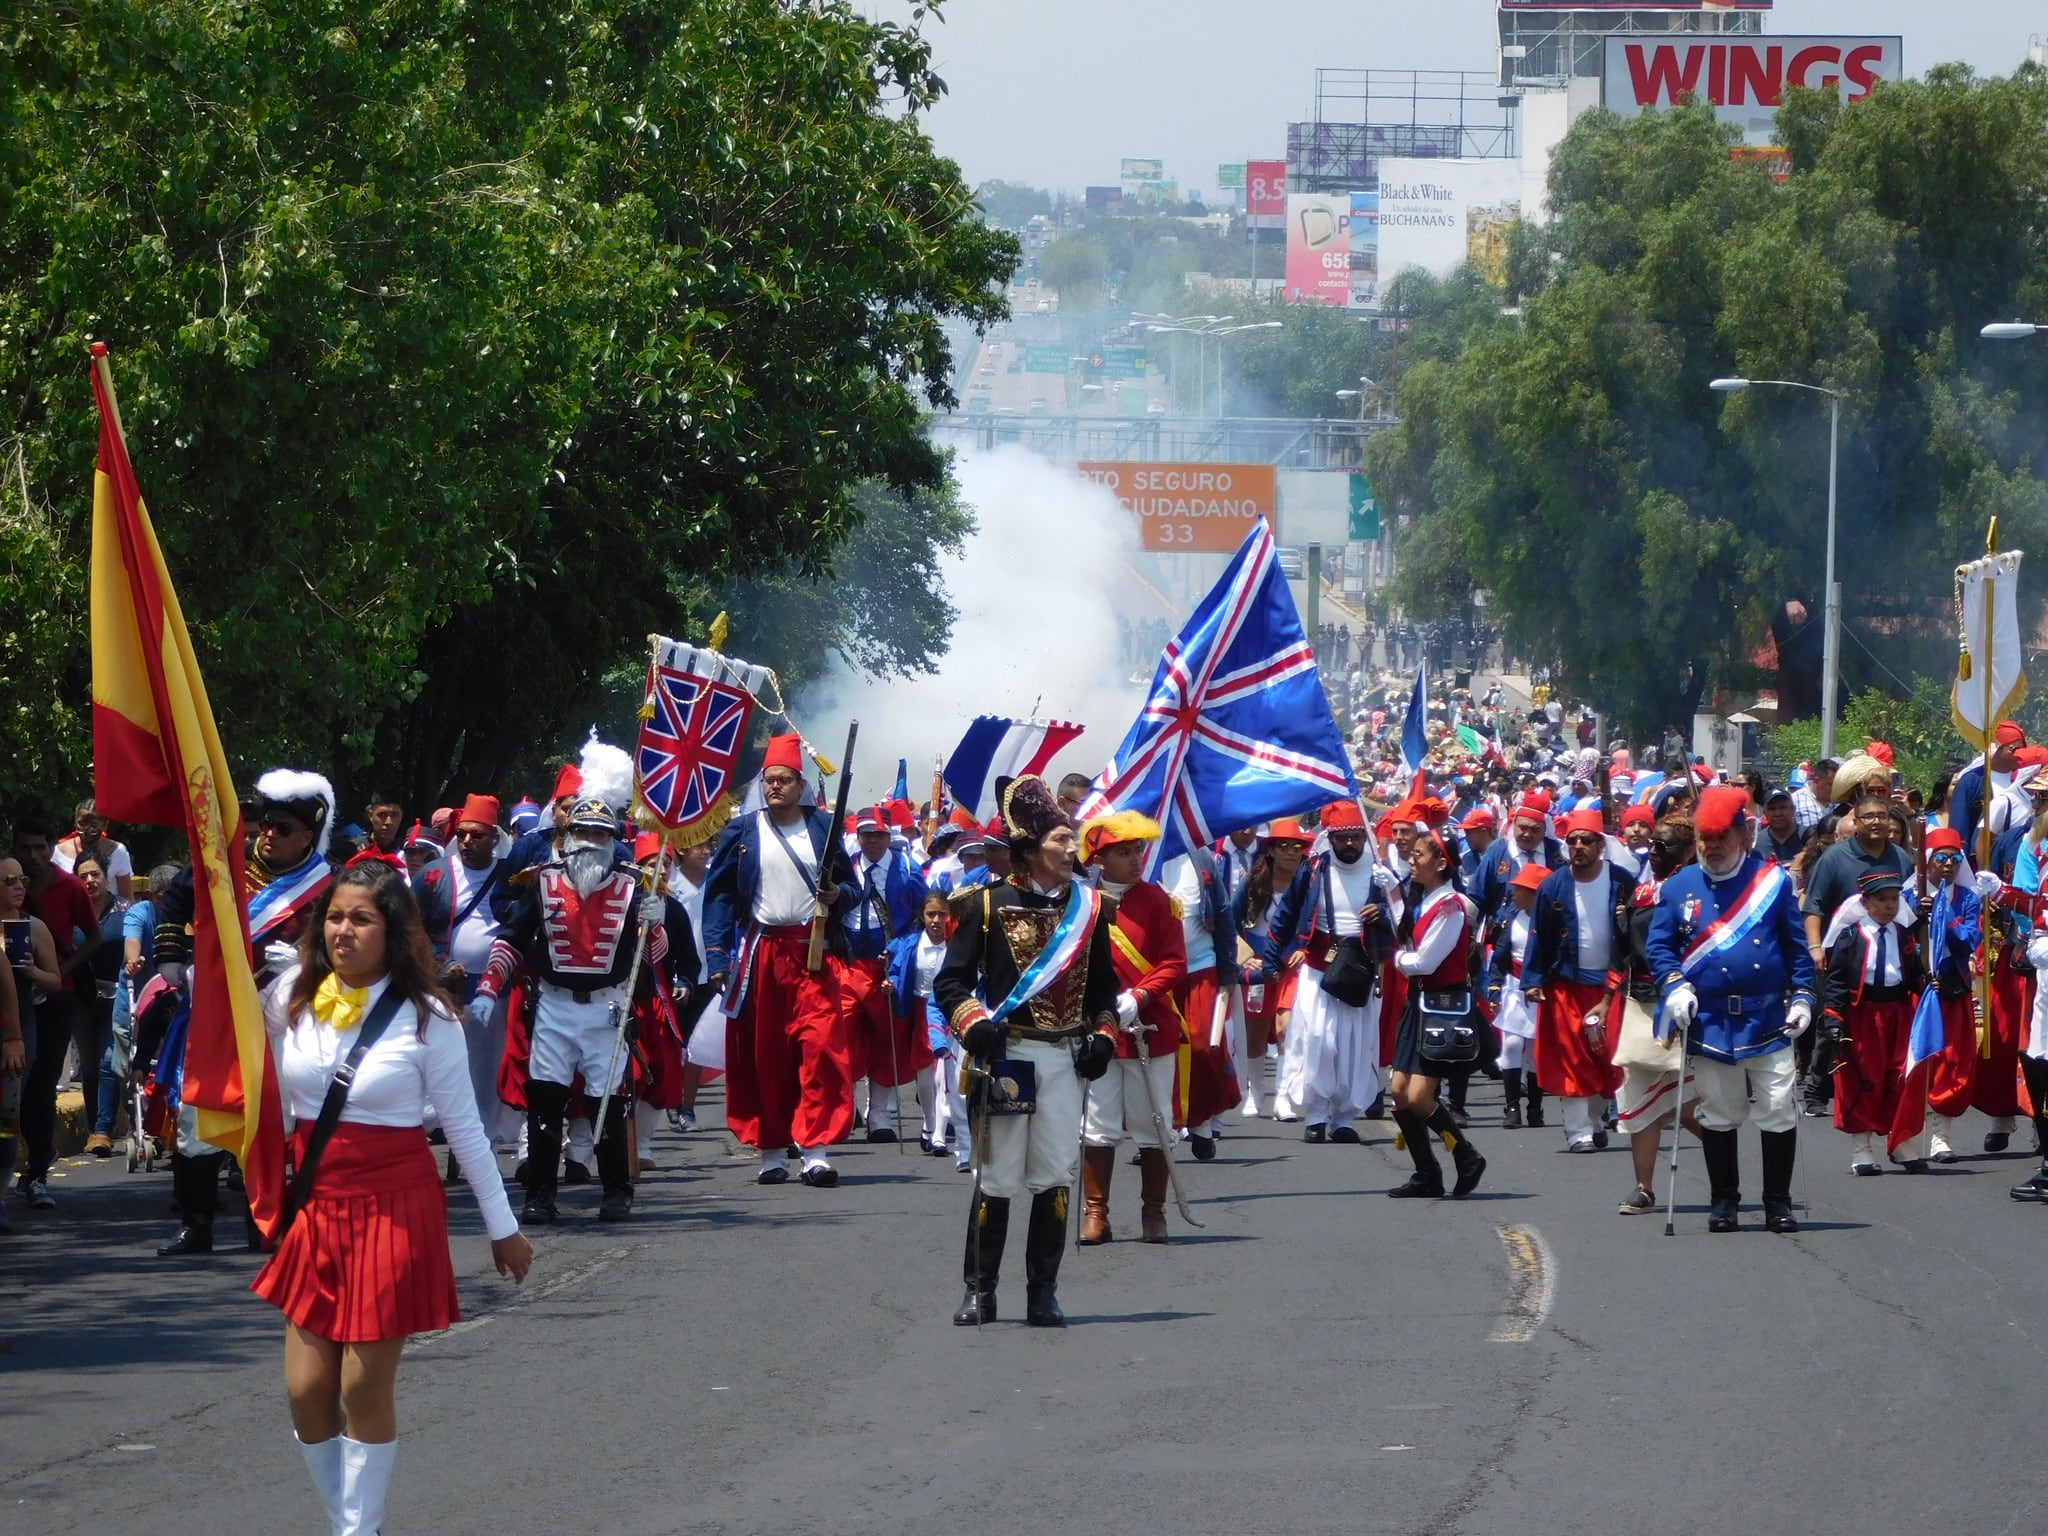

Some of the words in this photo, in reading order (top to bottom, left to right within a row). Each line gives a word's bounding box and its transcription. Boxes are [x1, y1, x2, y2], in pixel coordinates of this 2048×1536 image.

[1625, 45, 1883, 106] WINGS
[1380, 214, 1455, 227] BUCHANAN'S
[1133, 471, 1232, 491] SEGURO
[1119, 497, 1257, 518] CIUDADANO
[1159, 523, 1195, 543] 33
